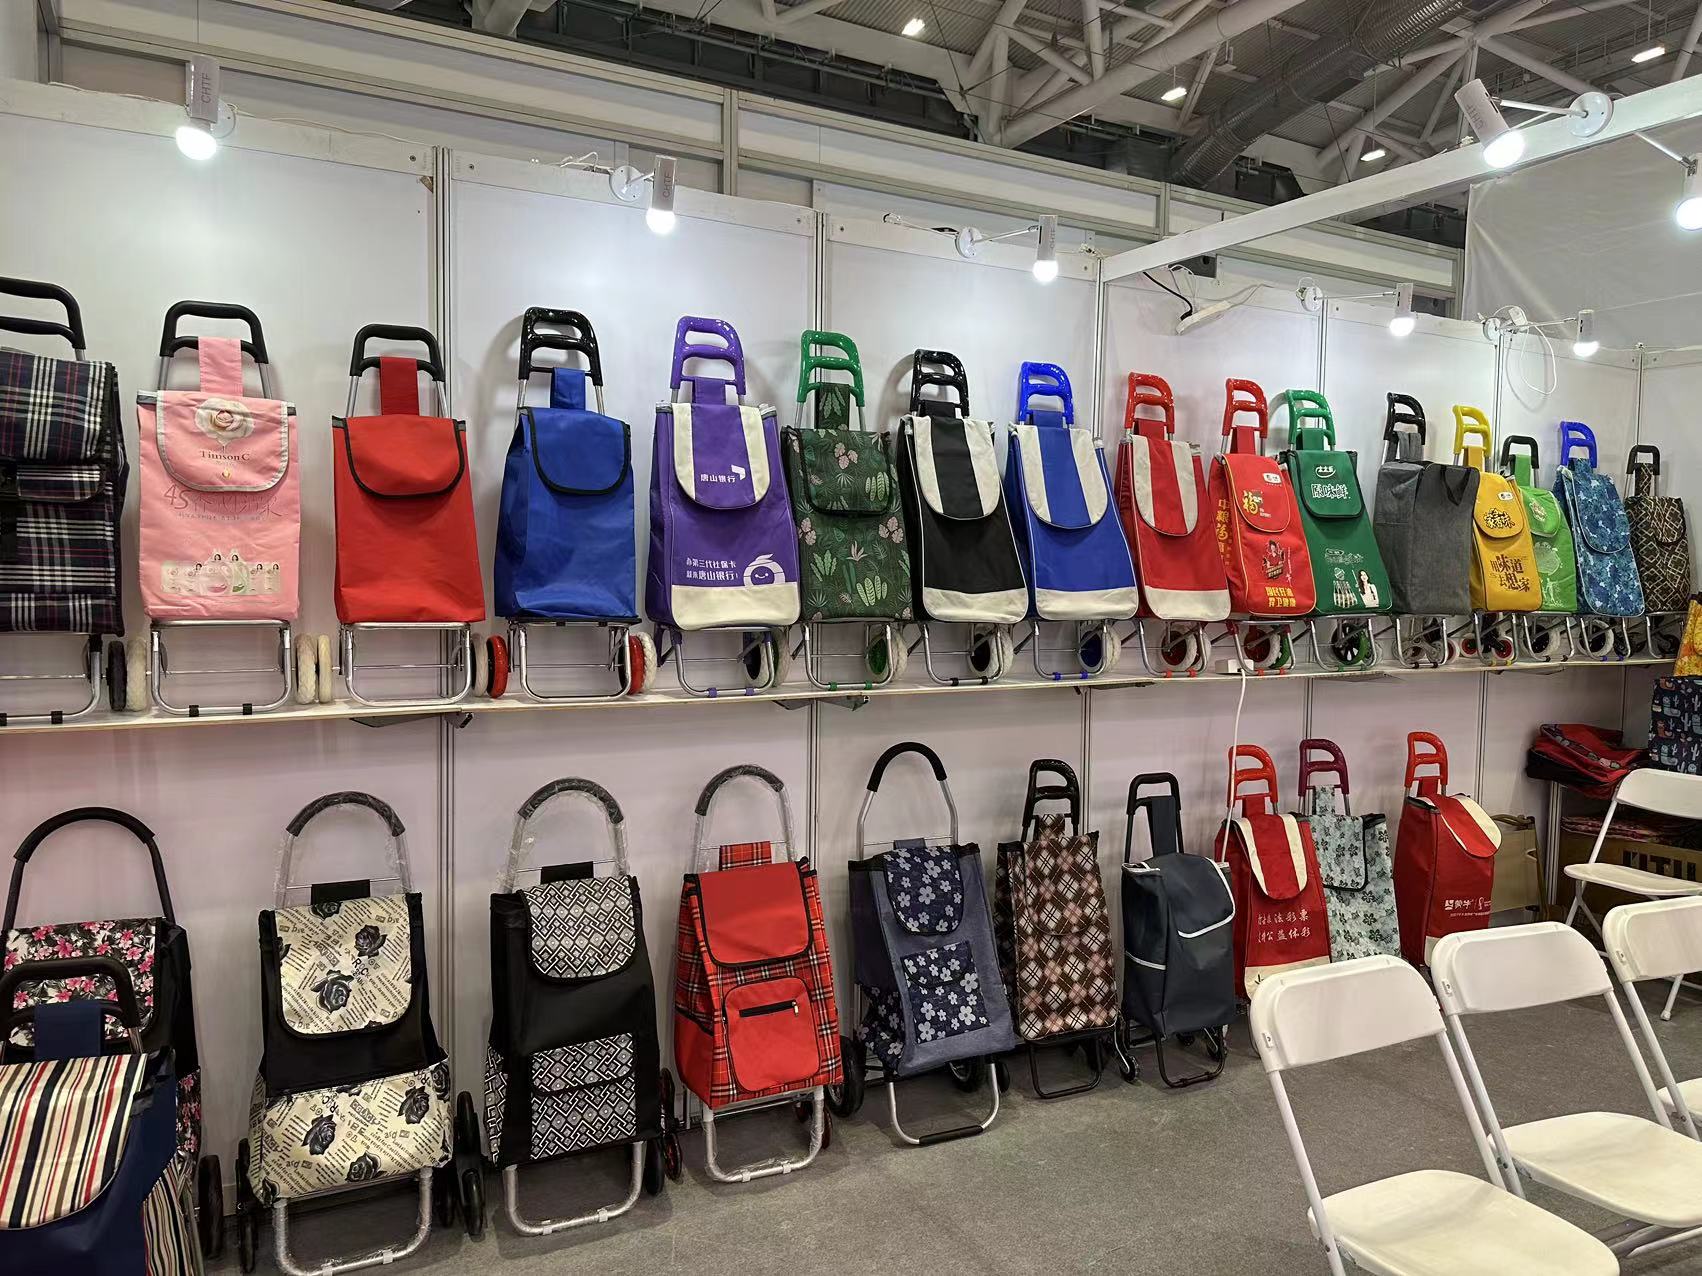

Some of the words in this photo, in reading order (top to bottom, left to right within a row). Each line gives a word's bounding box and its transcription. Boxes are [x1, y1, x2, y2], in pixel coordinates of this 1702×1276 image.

[201, 72, 212, 104] CHTF
[700, 473, 736, 483] 唐山银行
